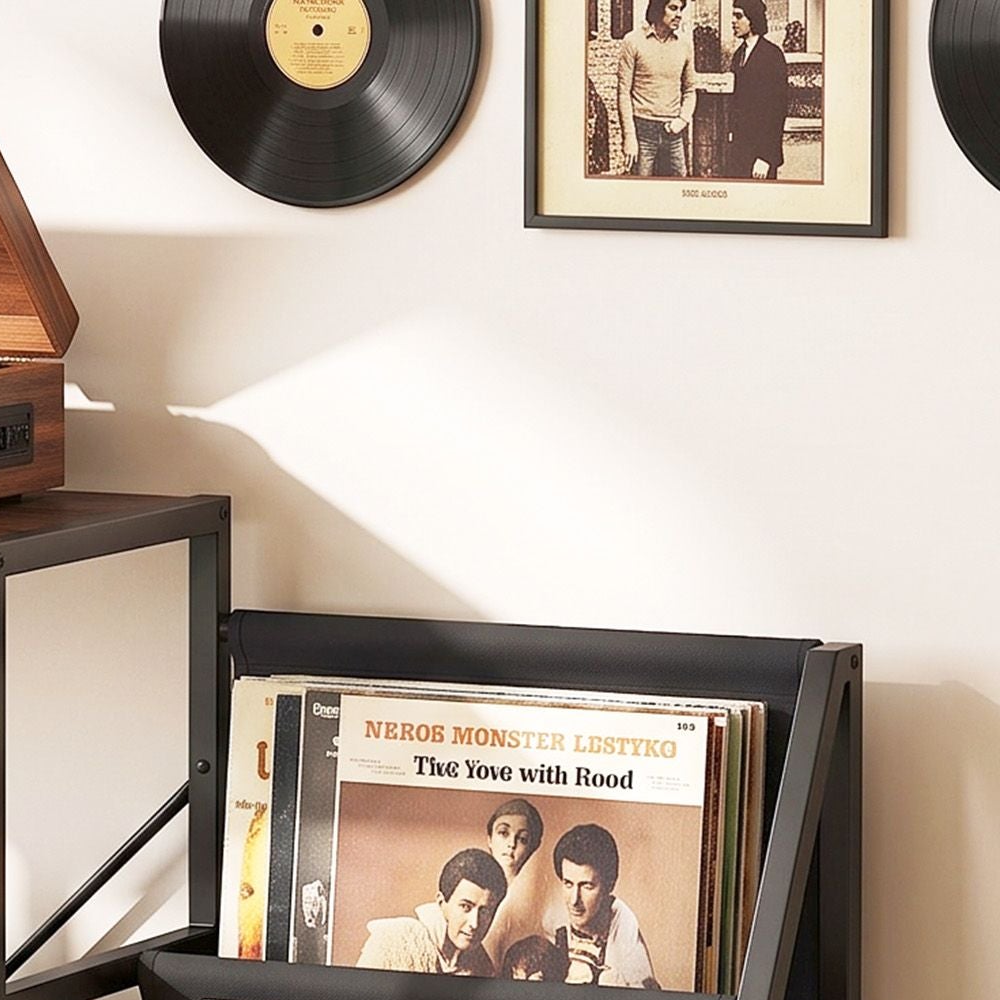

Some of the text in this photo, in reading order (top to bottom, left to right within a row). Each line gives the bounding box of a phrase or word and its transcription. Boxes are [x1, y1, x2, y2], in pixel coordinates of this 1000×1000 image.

[451, 726, 566, 751] MONSTER
[519, 763, 568, 786] with
[575, 766, 634, 790] Rood
